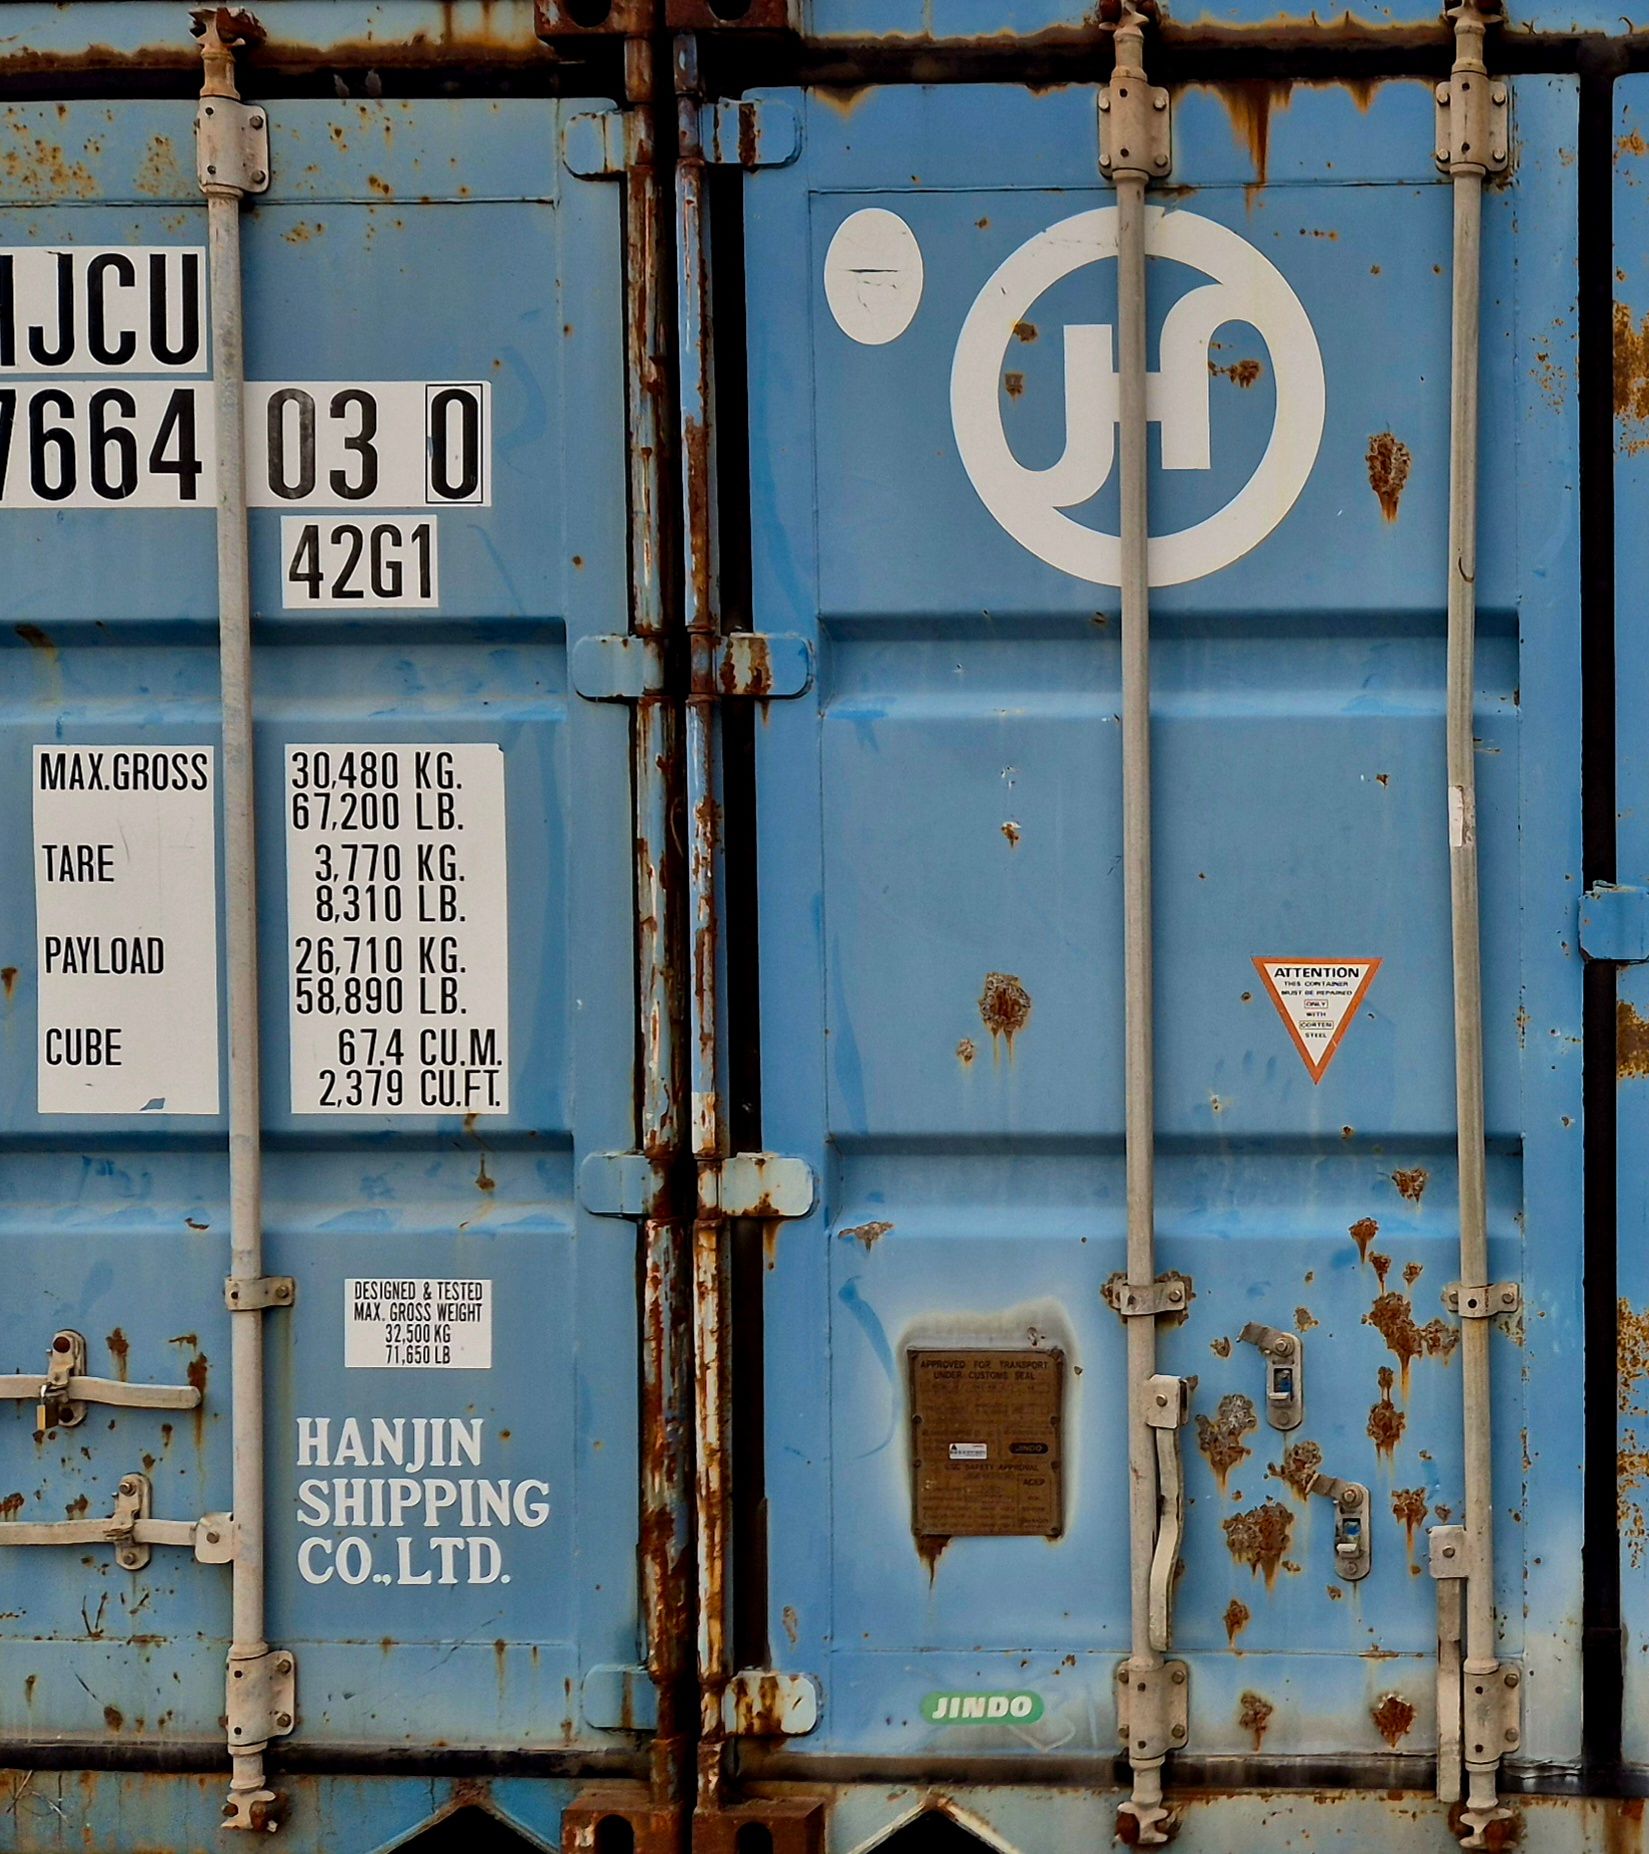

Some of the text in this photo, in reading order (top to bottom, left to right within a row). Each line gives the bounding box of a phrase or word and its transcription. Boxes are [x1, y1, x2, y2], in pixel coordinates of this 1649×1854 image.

[0, 253, 199, 367] JCU
[267, 388, 379, 500] 03
[430, 388, 478, 499] 0
[288, 524, 432, 599] 42G1
[40, 752, 209, 791] MAX.GROSS
[291, 751, 463, 791] 30,480 KG.
[292, 792, 464, 832] 67,200 LB.
[42, 844, 115, 882] TARE
[315, 844, 465, 884] 3,770 KG.
[316, 885, 466, 924] 8,310 LB.
[45, 937, 164, 974] PAYLOAD
[295, 936, 467, 976] 26,710 KG.
[1274, 967, 1359, 978] ATTENTION
[296, 978, 467, 1017] 58,890 LB.
[46, 1029, 122, 1066] CUBE
[338, 1029, 502, 1066] 67.4 CU.M.
[319, 1070, 501, 1109] 2,379 CU.FT.
[354, 1281, 482, 1301] DESIGNED & TESTED
[354, 1303, 482, 1322] MAX. GROSS WEIGHT
[385, 1324, 450, 1344] 32,500 KG
[386, 1345, 450, 1365] 71,650 LB
[296, 1417, 484, 1473] HANJIN
[297, 1478, 550, 1527] SHIPPING
[932, 1696, 1033, 1719] JINDO
